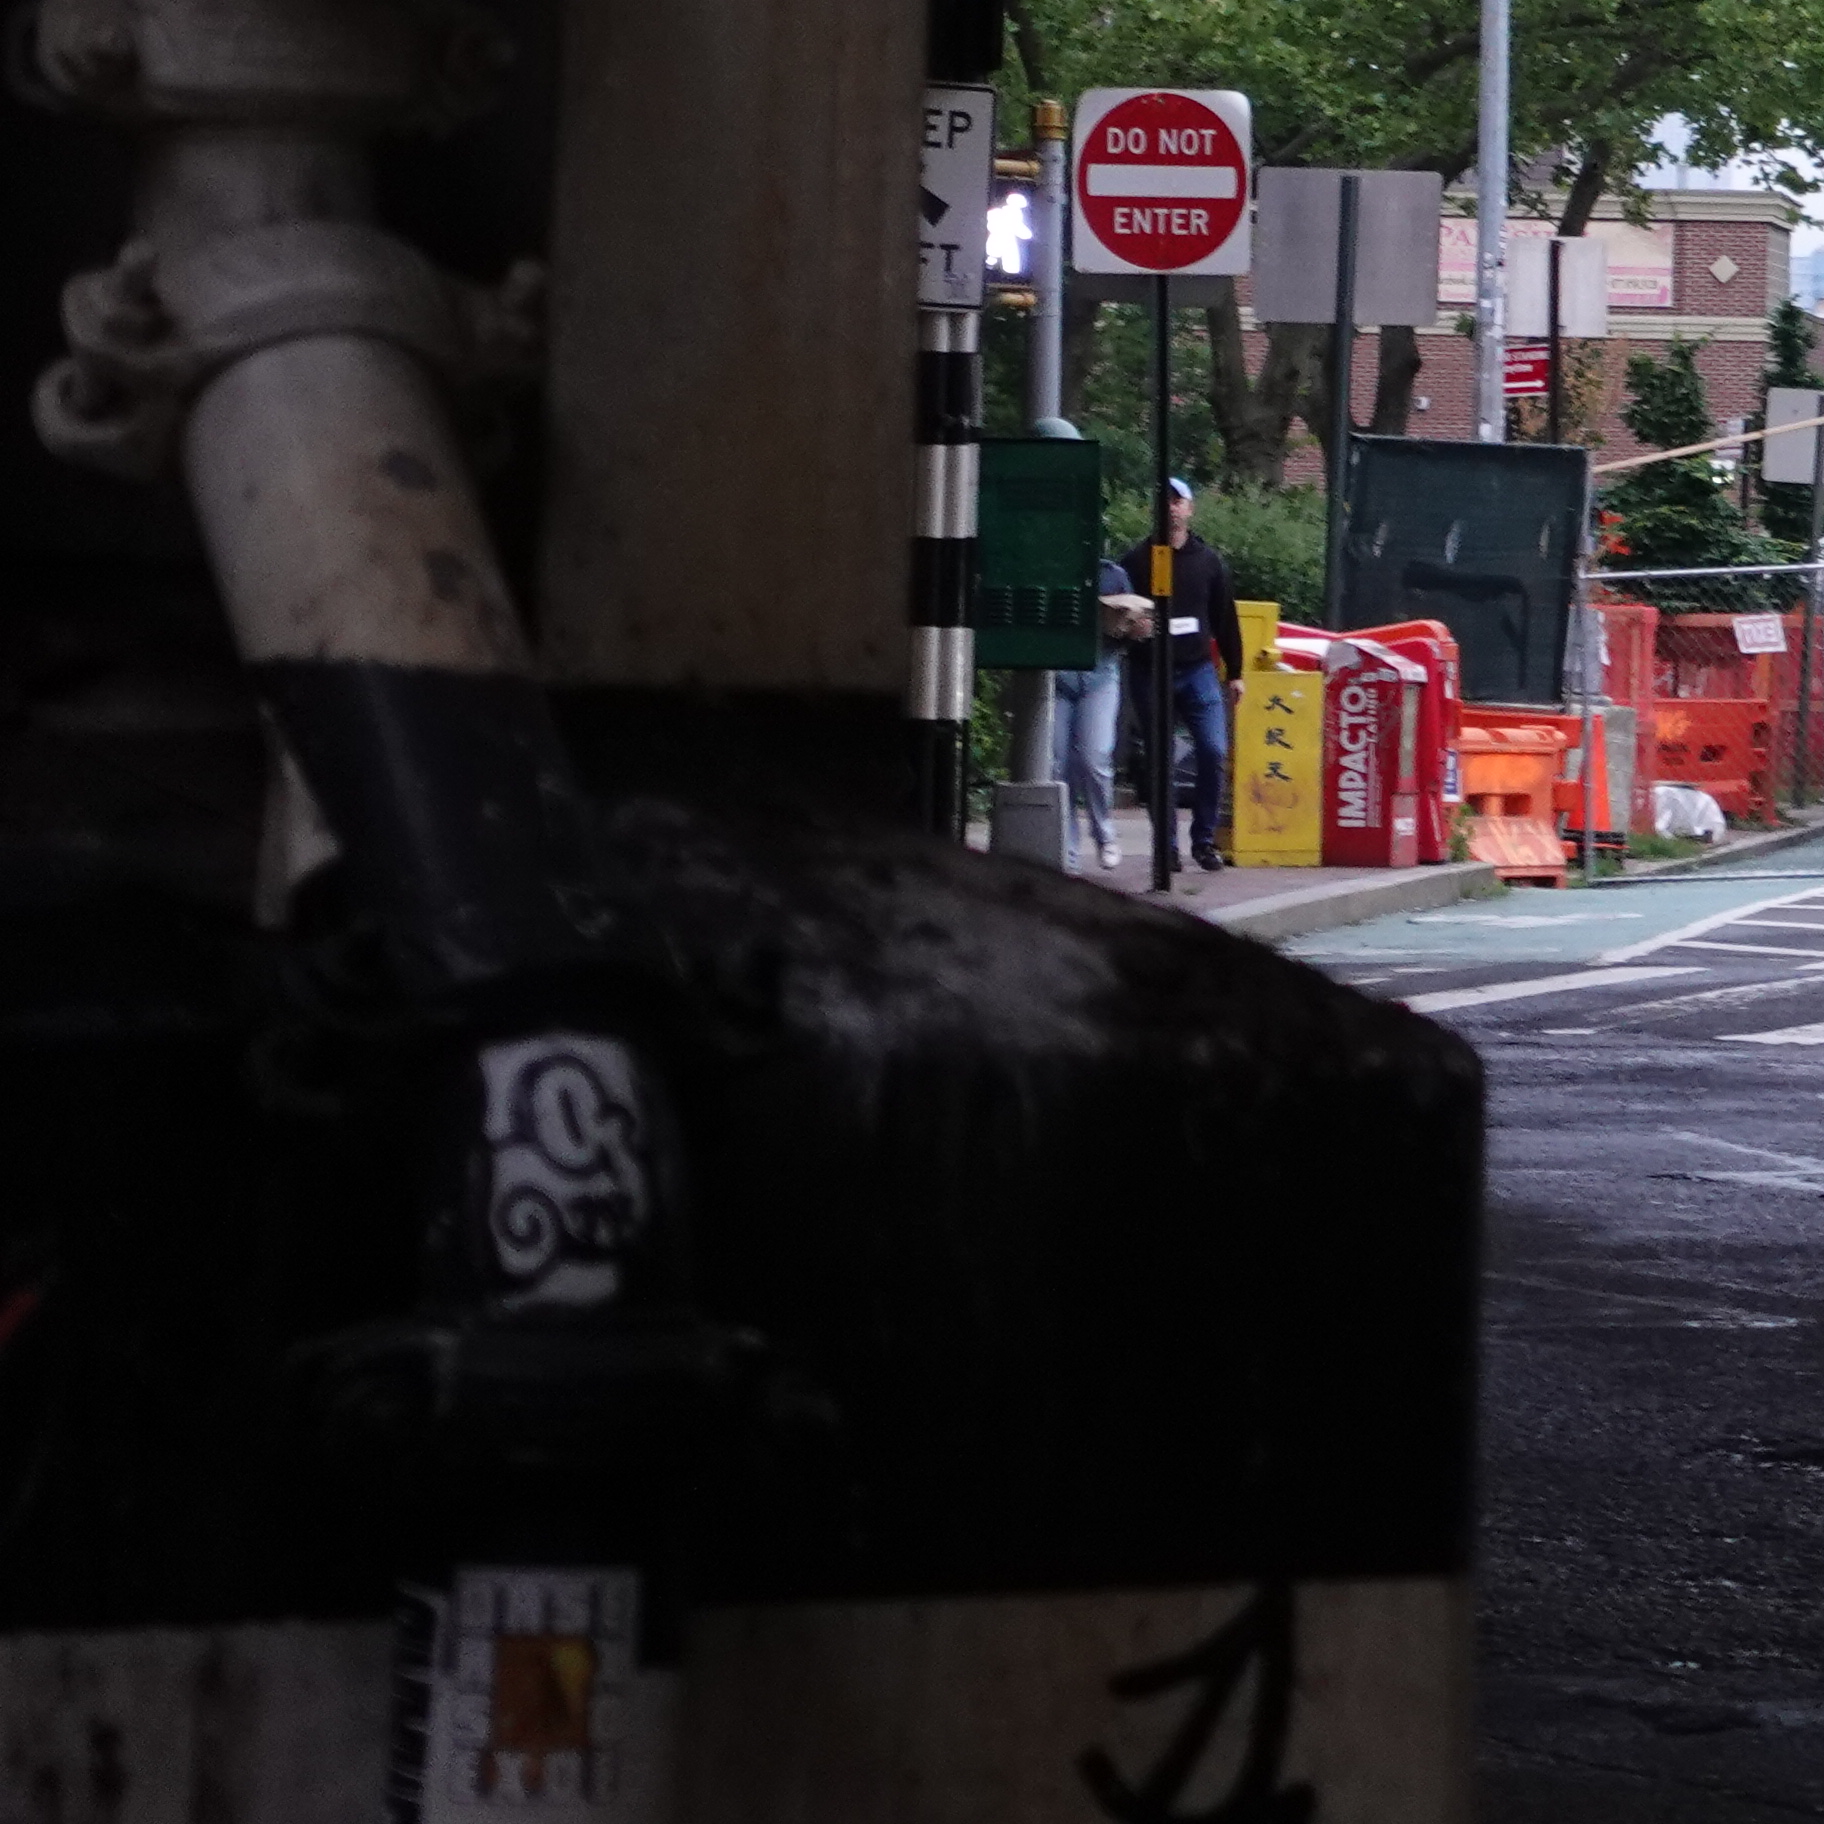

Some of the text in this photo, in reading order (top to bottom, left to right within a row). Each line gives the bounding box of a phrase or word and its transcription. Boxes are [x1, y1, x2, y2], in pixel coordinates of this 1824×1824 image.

[922, 109, 972, 148] EP
[1106, 127, 1218, 156] DO NOT
[1113, 208, 1210, 236] ENTER
[1336, 685, 1367, 828] IMPACTO
